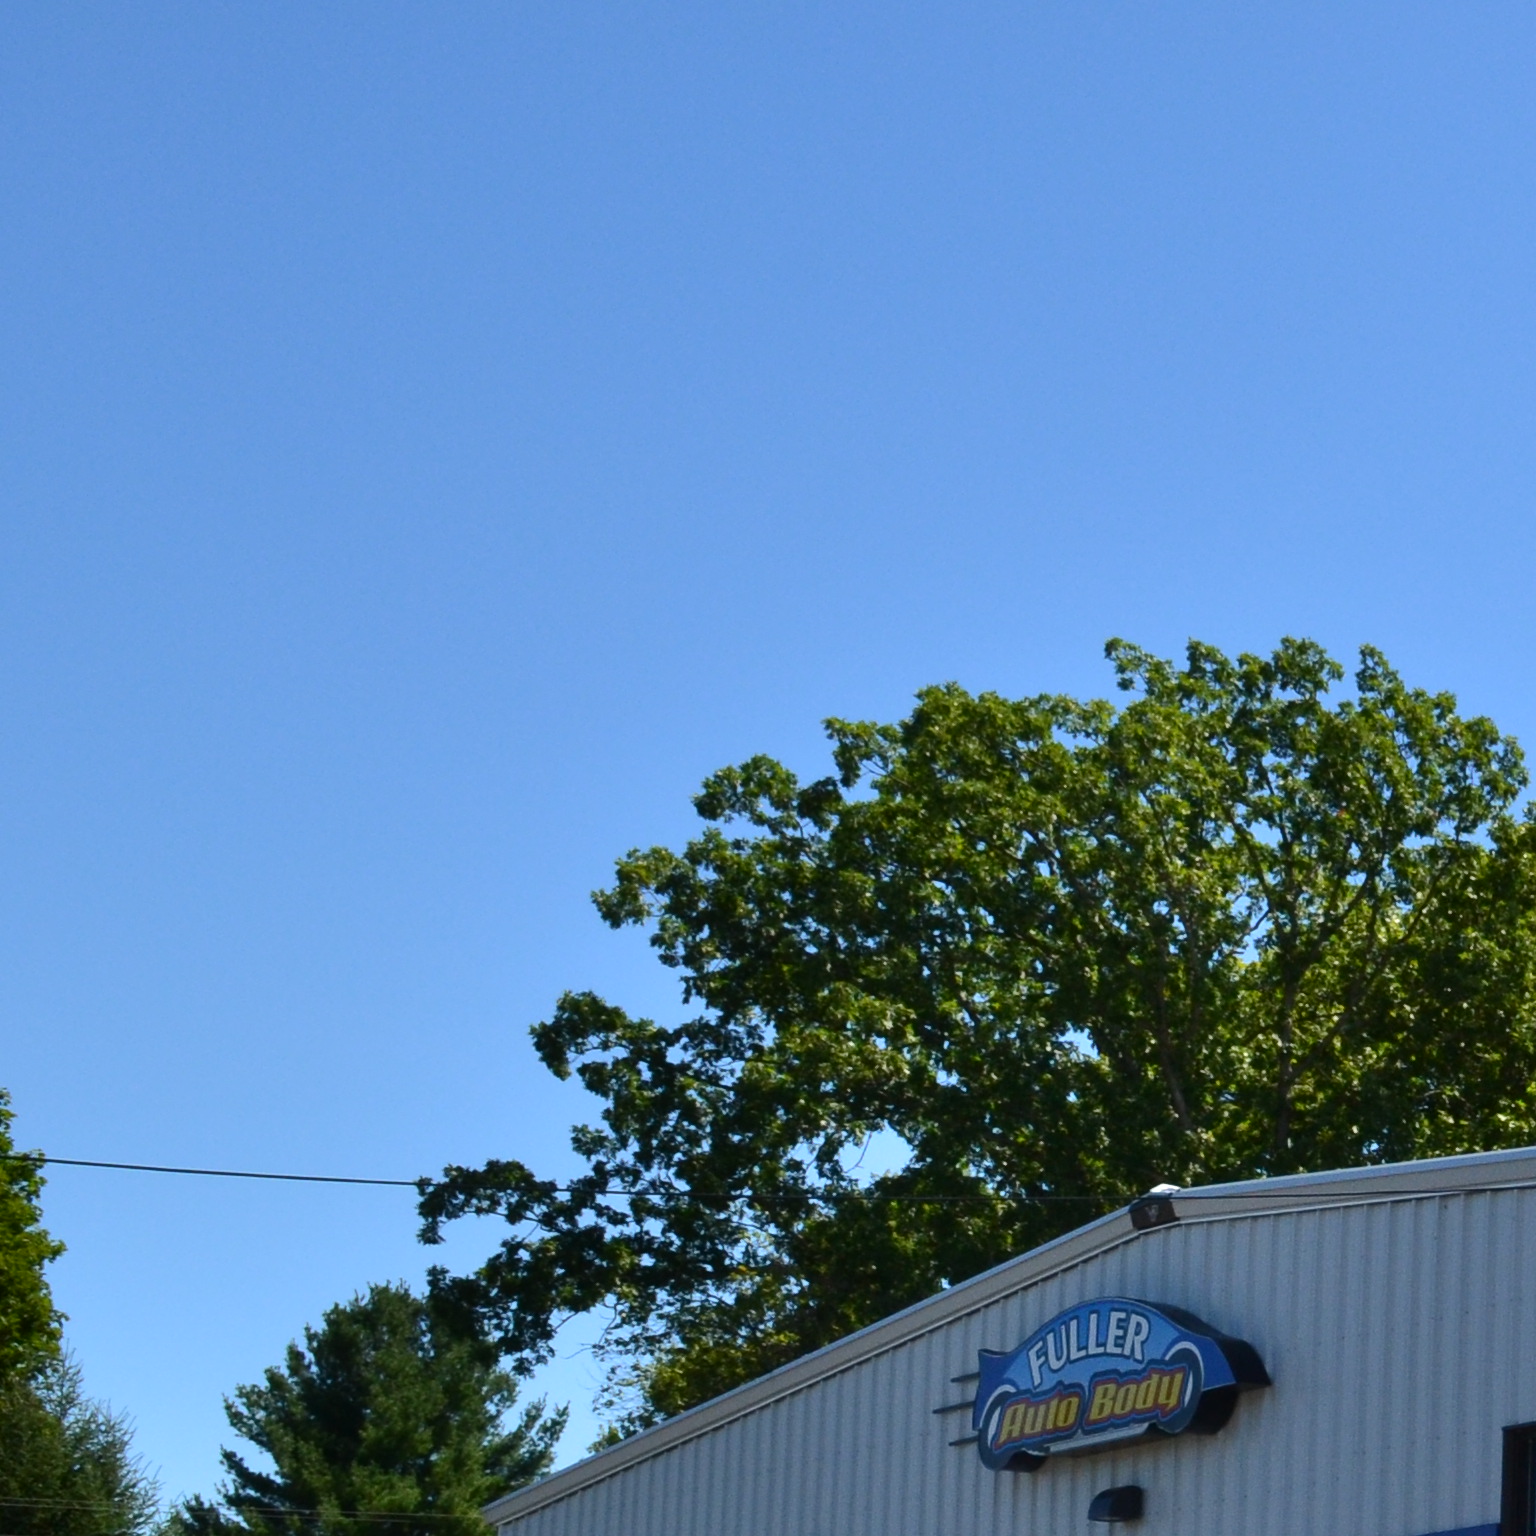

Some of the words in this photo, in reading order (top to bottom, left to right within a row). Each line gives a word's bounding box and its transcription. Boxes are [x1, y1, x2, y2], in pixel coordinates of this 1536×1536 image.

[1027, 1309, 1150, 1387] FULLER
[994, 1392, 1082, 1450] Auto
[1085, 1370, 1187, 1425] Body
